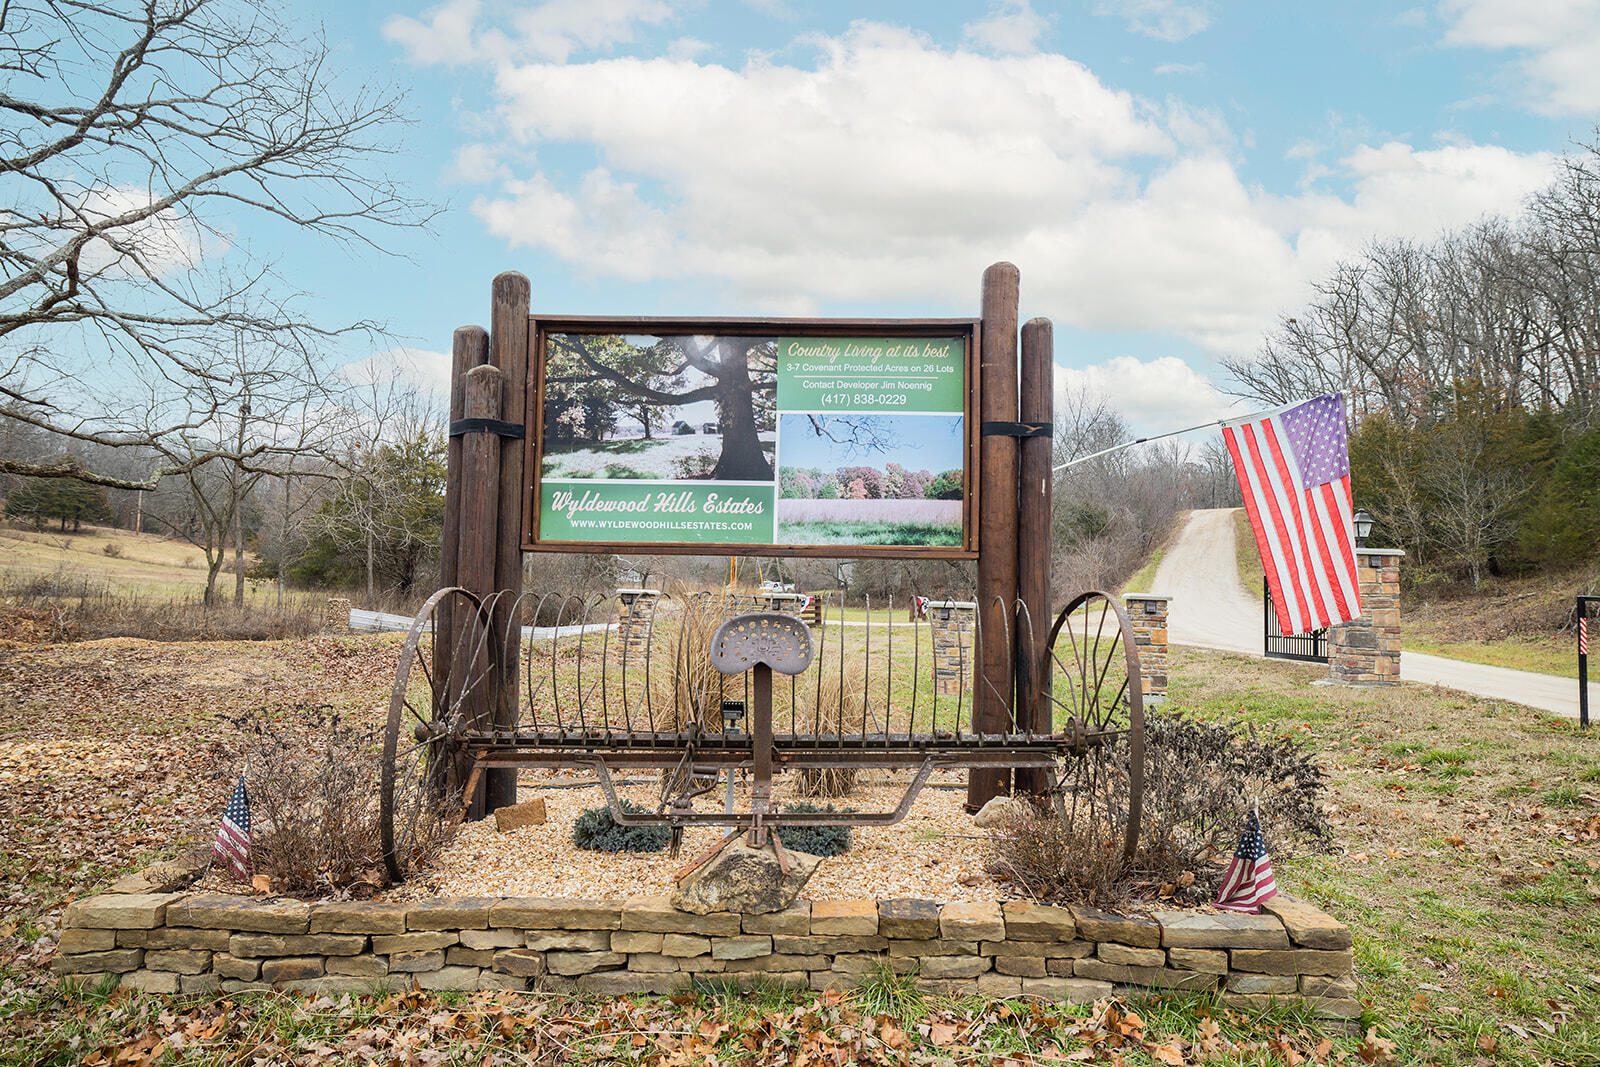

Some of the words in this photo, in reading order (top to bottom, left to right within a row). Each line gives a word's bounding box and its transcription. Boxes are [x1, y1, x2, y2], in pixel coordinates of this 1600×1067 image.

[787, 342, 841, 363] Country
[844, 343, 883, 364] Living
[886, 344, 902, 357] at
[903, 344, 920, 357] its
[922, 343, 950, 358] best
[786, 363, 800, 372] 3-7
[802, 363, 842, 372] Covenant
[844, 364, 883, 372] Protected
[885, 364, 909, 372] Acres
[923, 364, 935, 373] 26
[936, 364, 955, 373] Lots
[803, 380, 835, 389] Contact
[837, 381, 880, 391] Developer
[881, 381, 896, 390] Jim
[897, 381, 933, 392] Noennig
[821, 393, 851, 407] (417)
[853, 393, 907, 405] 838-0229
[551, 490, 651, 519] Wyldewood
[653, 491, 697, 513] Hills
[702, 493, 765, 515] Estates
[570, 519, 753, 531] WWW.WYLDEWOODHILLSESTATES.COM
